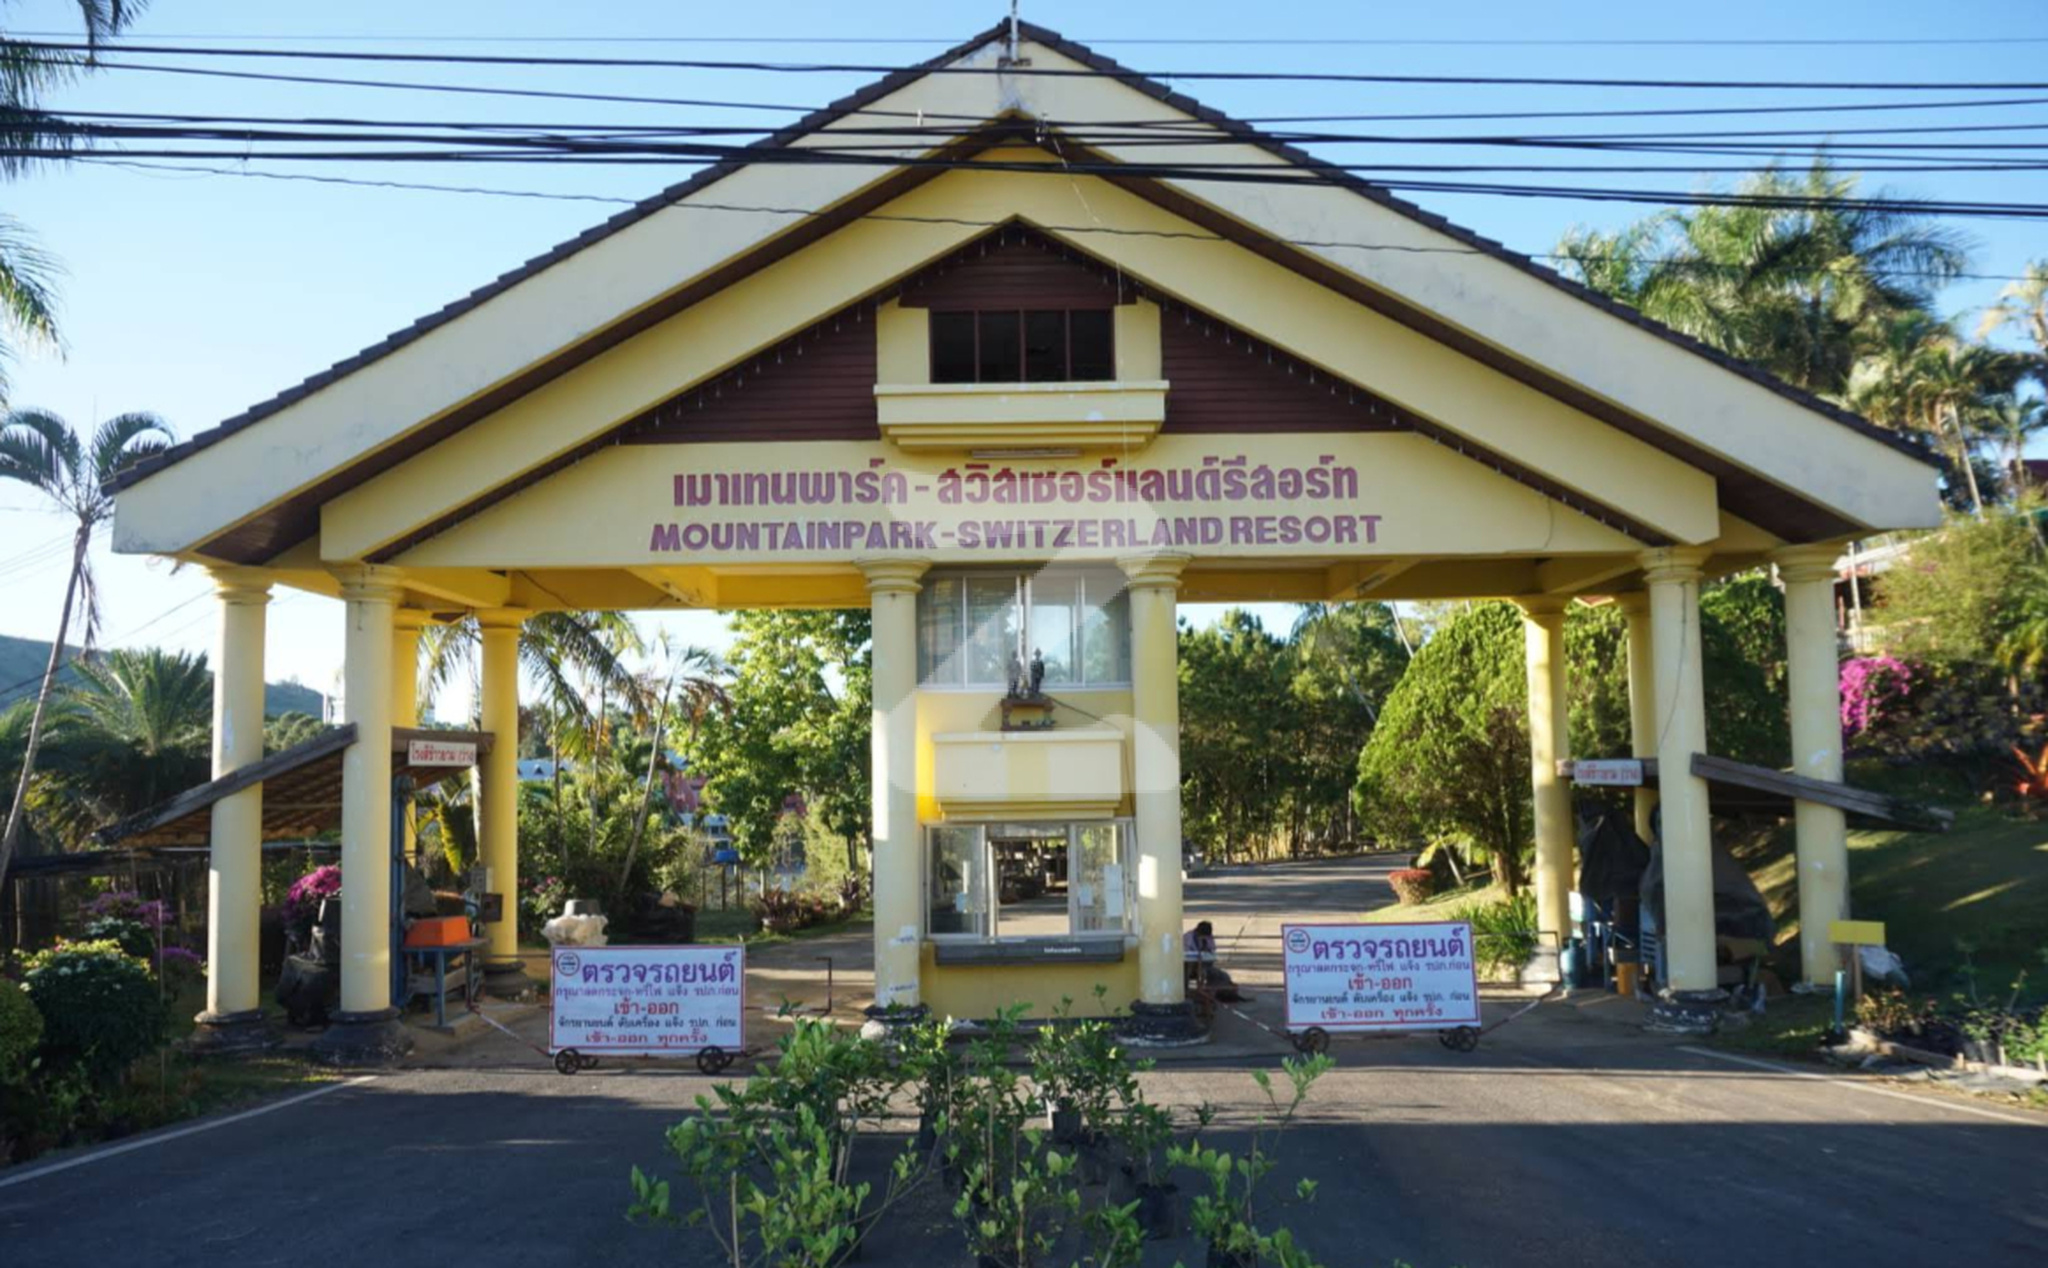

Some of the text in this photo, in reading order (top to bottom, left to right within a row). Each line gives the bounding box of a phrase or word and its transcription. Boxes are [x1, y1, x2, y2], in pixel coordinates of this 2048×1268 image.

[1312, 927, 1465, 960] ตรวจรถยนต์
[582, 951, 737, 984] ตรวจรถยนต์
[1347, 973, 1412, 991] เข้า-ออก
[613, 998, 679, 1015] เข้า-ออก
